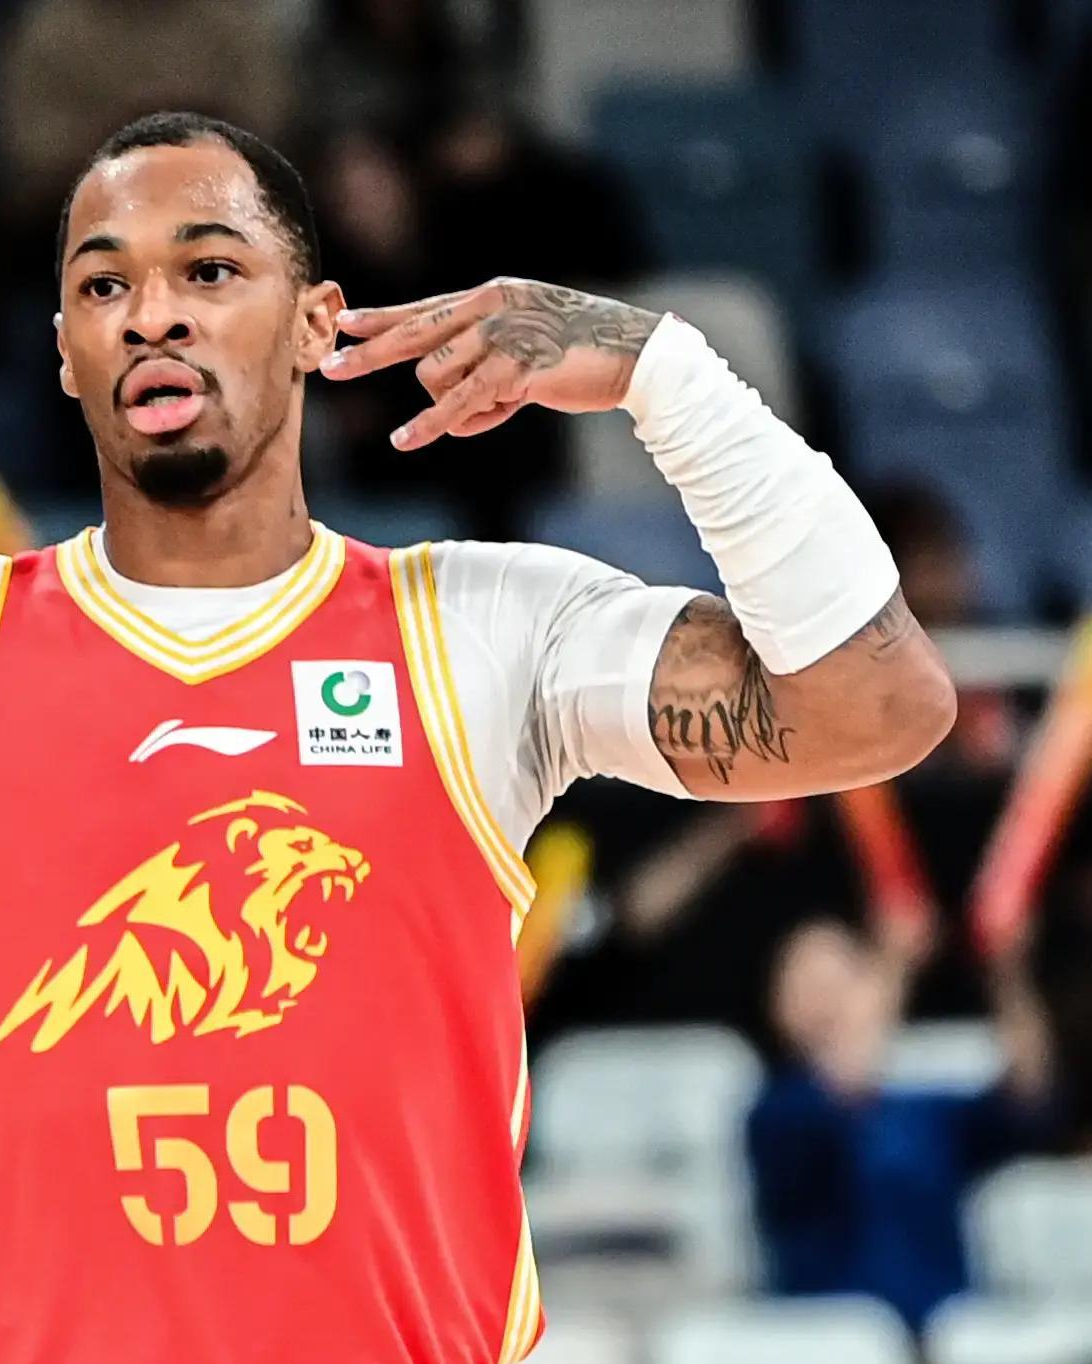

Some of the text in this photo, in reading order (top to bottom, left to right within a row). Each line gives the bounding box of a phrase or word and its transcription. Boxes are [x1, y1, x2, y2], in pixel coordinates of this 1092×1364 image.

[309, 727, 391, 742] 中国人寿
[310, 745, 391, 754] CHINA LIFE
[107, 1083, 338, 1246] 59
